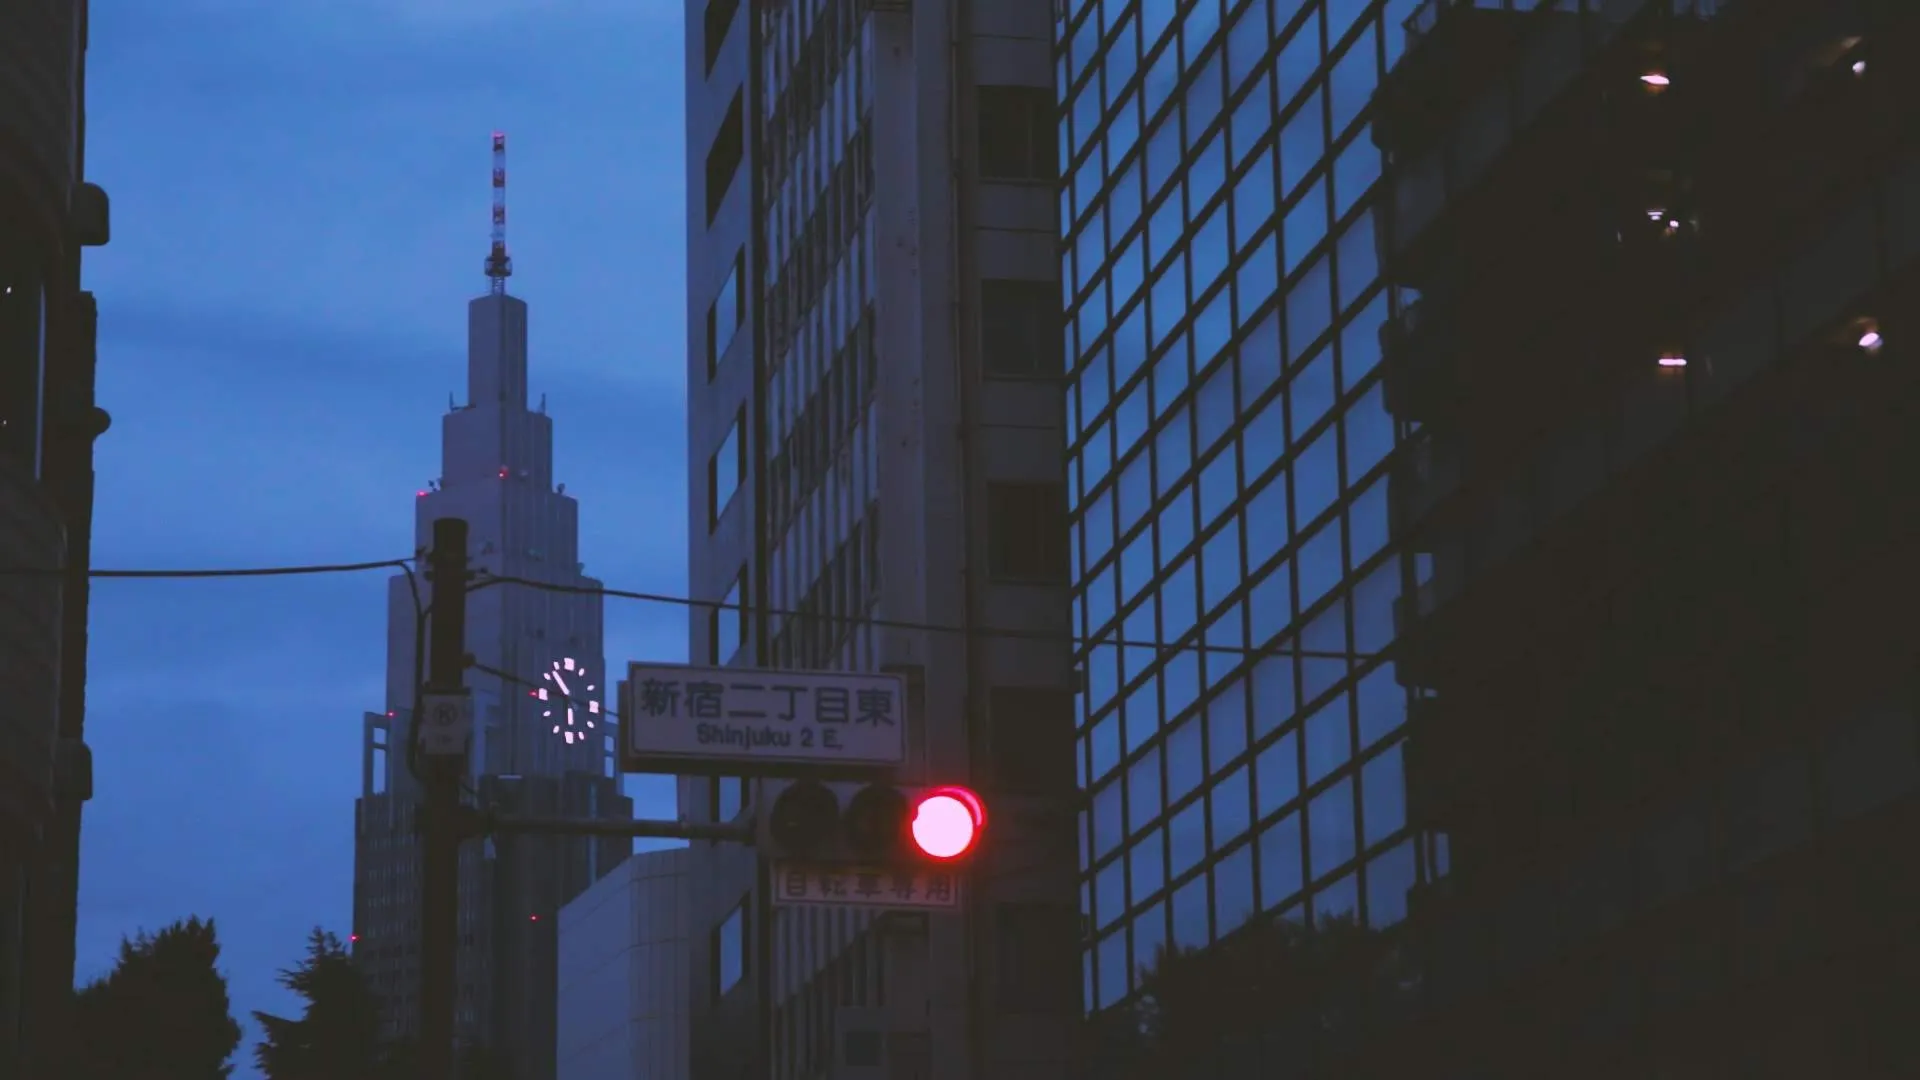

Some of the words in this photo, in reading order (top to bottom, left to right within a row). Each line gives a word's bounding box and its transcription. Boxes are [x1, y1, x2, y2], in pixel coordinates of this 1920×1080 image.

[641, 677, 896, 727] 新宿二丁目東
[695, 723, 791, 750] Shinjuku
[800, 727, 814, 748] 2
